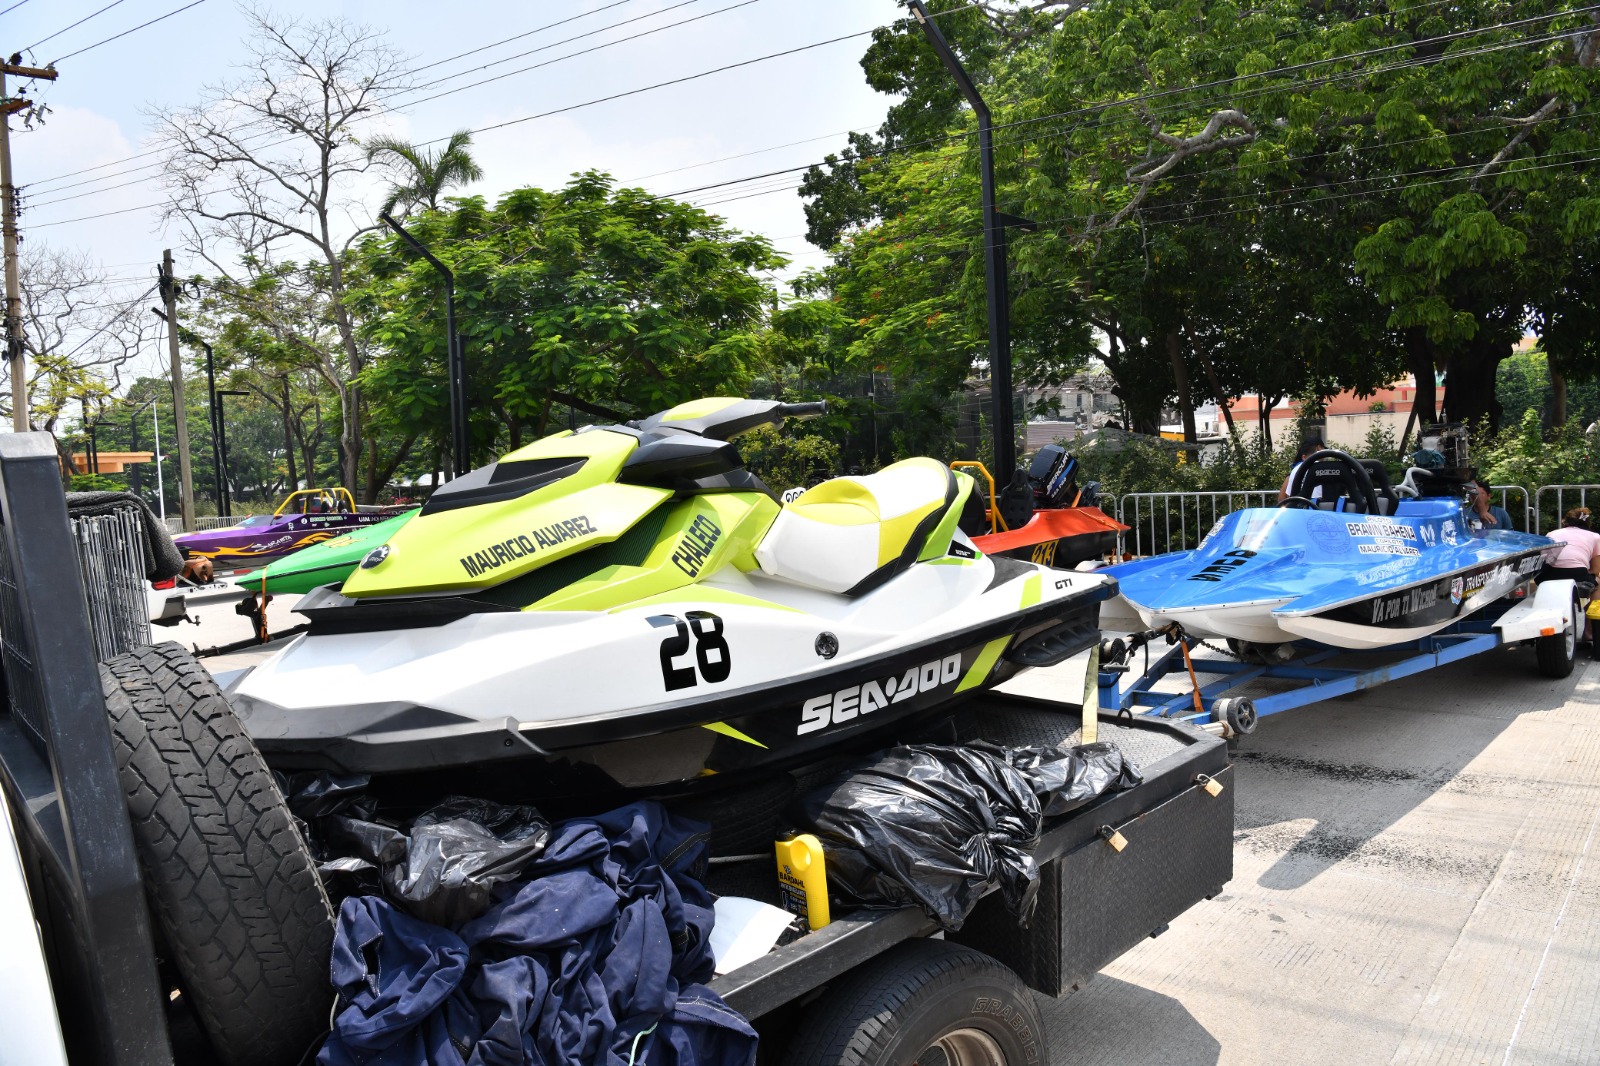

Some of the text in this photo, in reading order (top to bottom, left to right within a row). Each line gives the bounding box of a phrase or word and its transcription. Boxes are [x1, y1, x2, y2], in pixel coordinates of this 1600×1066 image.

[1046, 450, 1069, 496] MERCURY
[460, 515, 598, 578] MAURICIO ALVAREZ
[671, 514, 722, 578] CHALECO
[1347, 523, 1416, 539] BRAWN BAHENA
[1360, 545, 1419, 557] MAURICIO ALVAREZ
[1055, 578, 1073, 590] GTI
[645, 610, 731, 692] 28
[779, 871, 805, 889] BARDAHL
